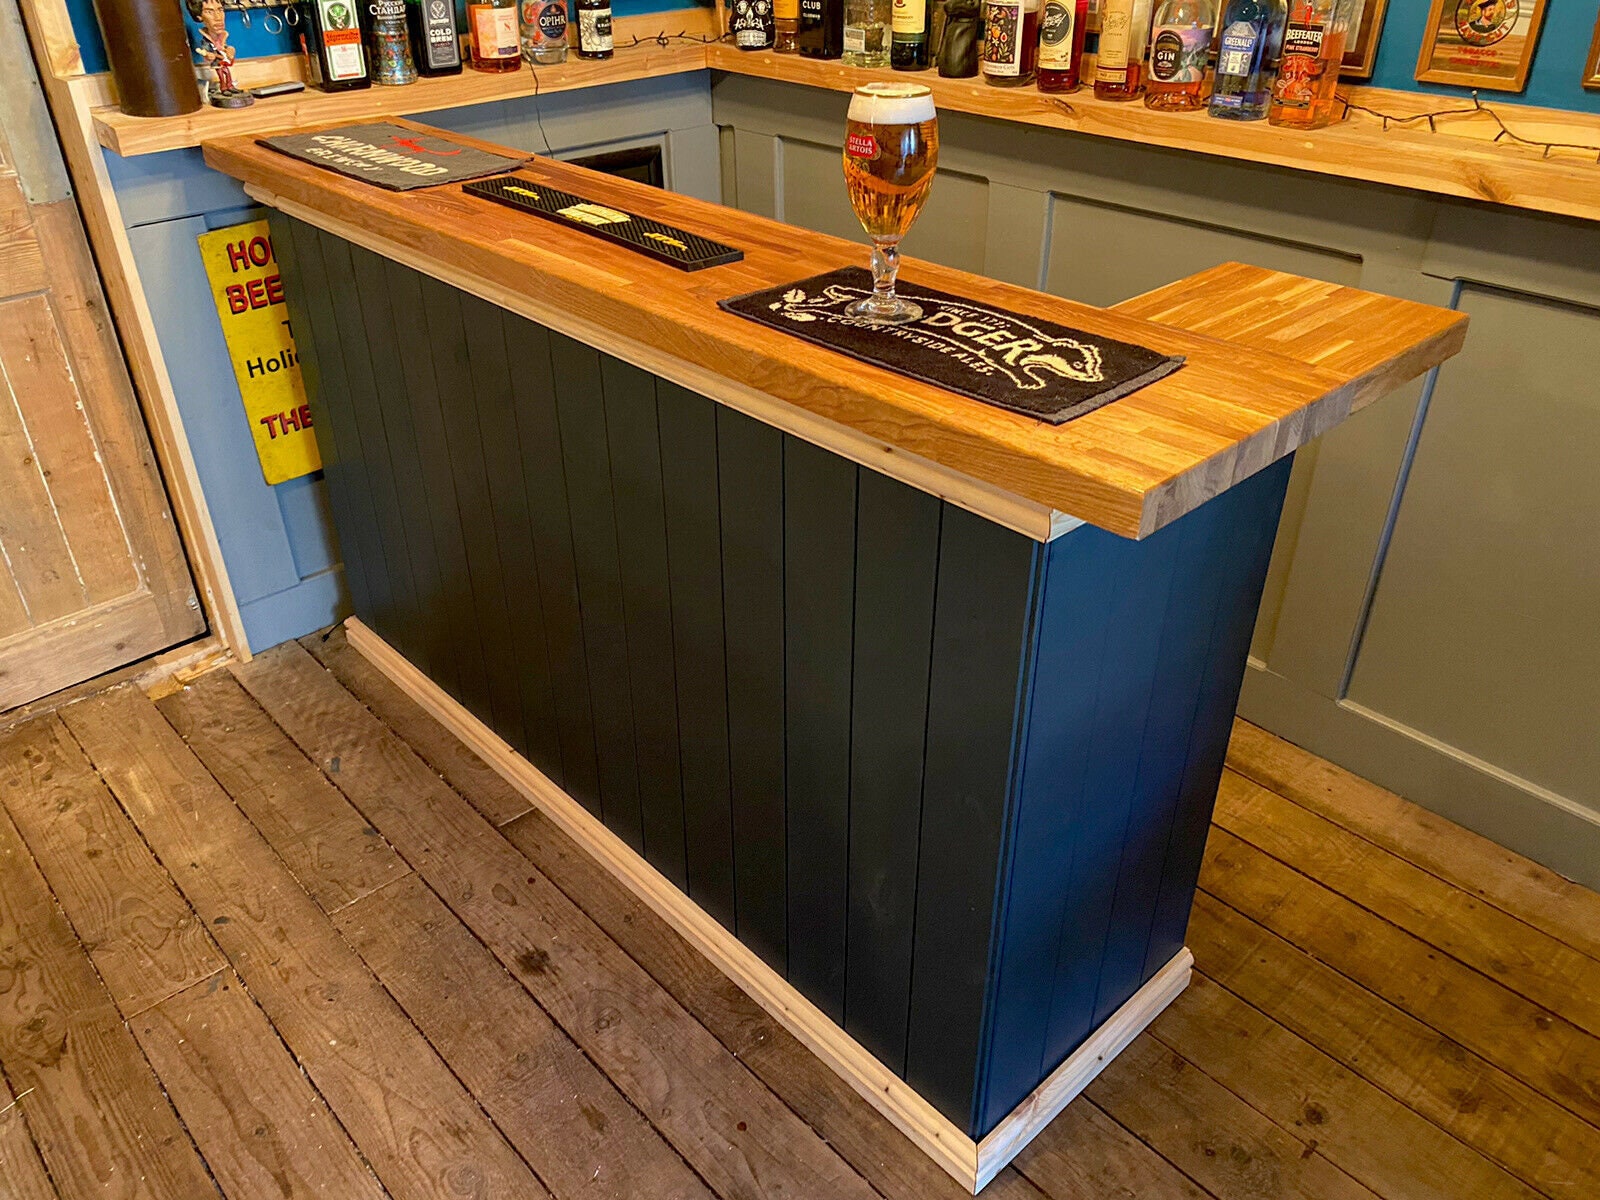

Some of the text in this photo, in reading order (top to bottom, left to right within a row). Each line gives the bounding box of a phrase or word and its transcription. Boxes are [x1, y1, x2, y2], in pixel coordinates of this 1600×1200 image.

[802, 0, 821, 10] CLUB
[539, 15, 566, 26] OPIHR
[430, 28, 452, 37] COLD
[1286, 29, 1323, 44] BEEFEATER
[1157, 52, 1175, 61] GIN
[849, 135, 873, 147] STELLA
[848, 143, 873, 155] ARTOIS
[225, 274, 286, 316] BEE
[827, 315, 954, 354] COUNTRYSIDE
[920, 311, 1044, 367] DGER
